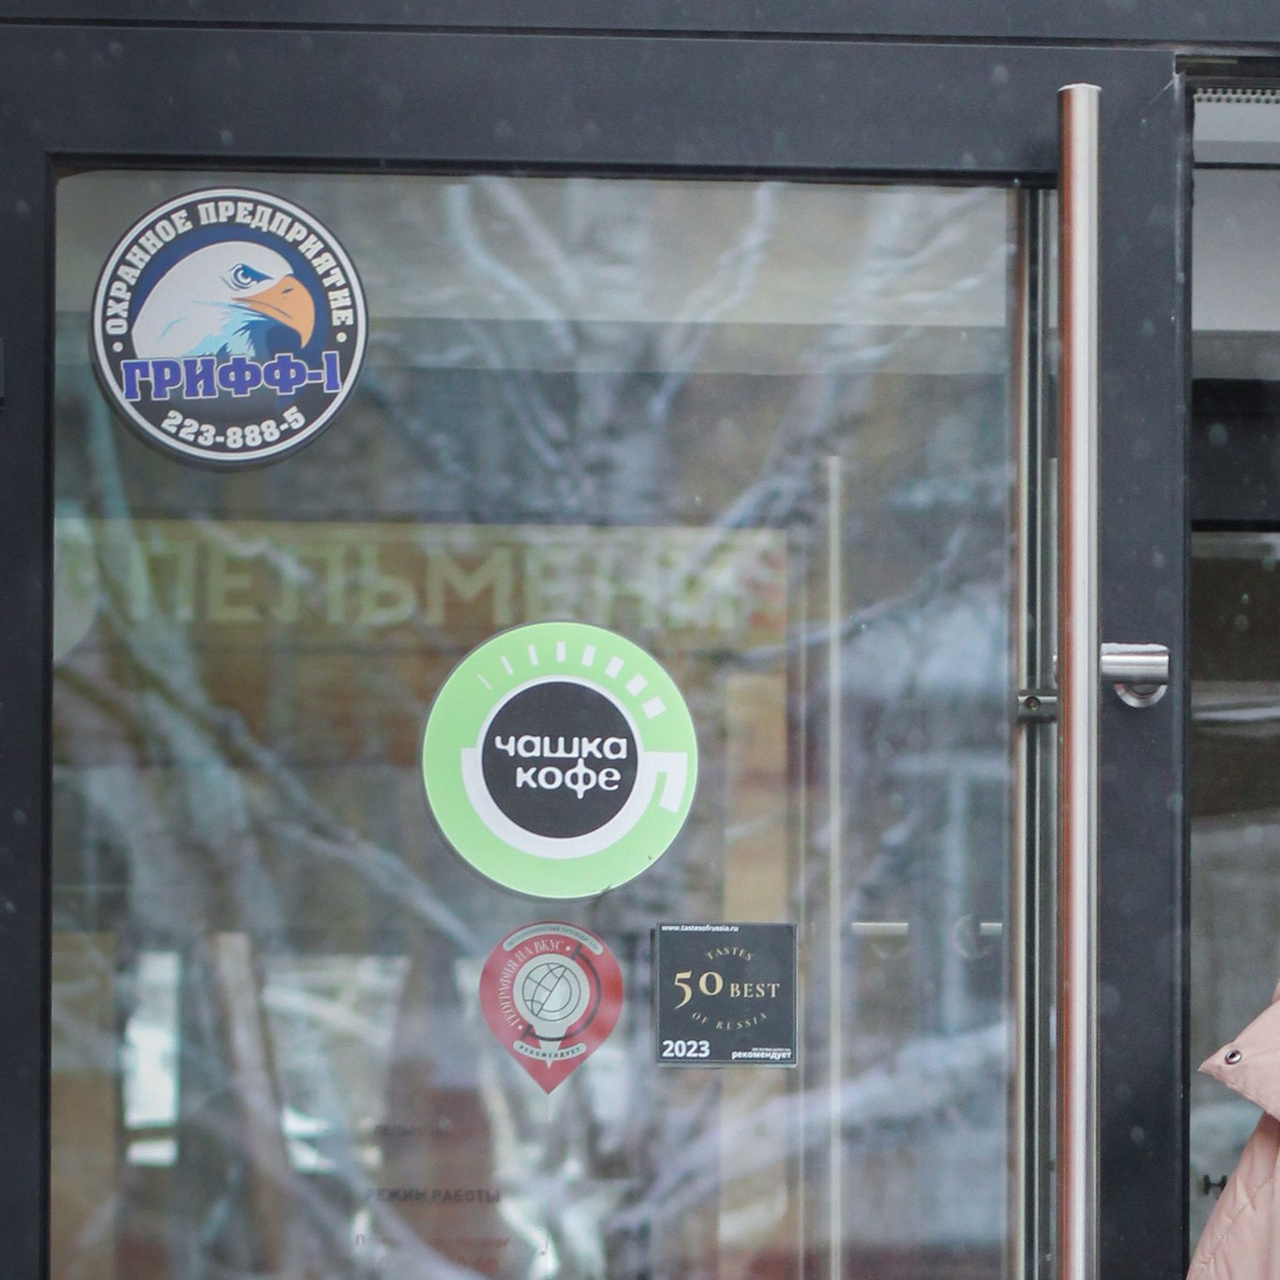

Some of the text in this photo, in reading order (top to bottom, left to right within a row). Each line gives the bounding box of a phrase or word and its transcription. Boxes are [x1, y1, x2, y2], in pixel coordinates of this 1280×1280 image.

[105, 200, 354, 336] ОХРАННОЕ ПРЕДПРИЯТИЕ
[160, 405, 306, 449] 223-888-5
[494, 734, 628, 760] чашка
[515, 757, 622, 800] кофе
[705, 945, 754, 962] TASTES
[672, 970, 781, 1010] 50 BEST
[691, 1011, 768, 1031] OF RUSSIA
[518, 1044, 582, 1059] РЕКОМЕНДУЕТ
[662, 1039, 711, 1058] 2023
[731, 1050, 792, 1061] рекомендует
